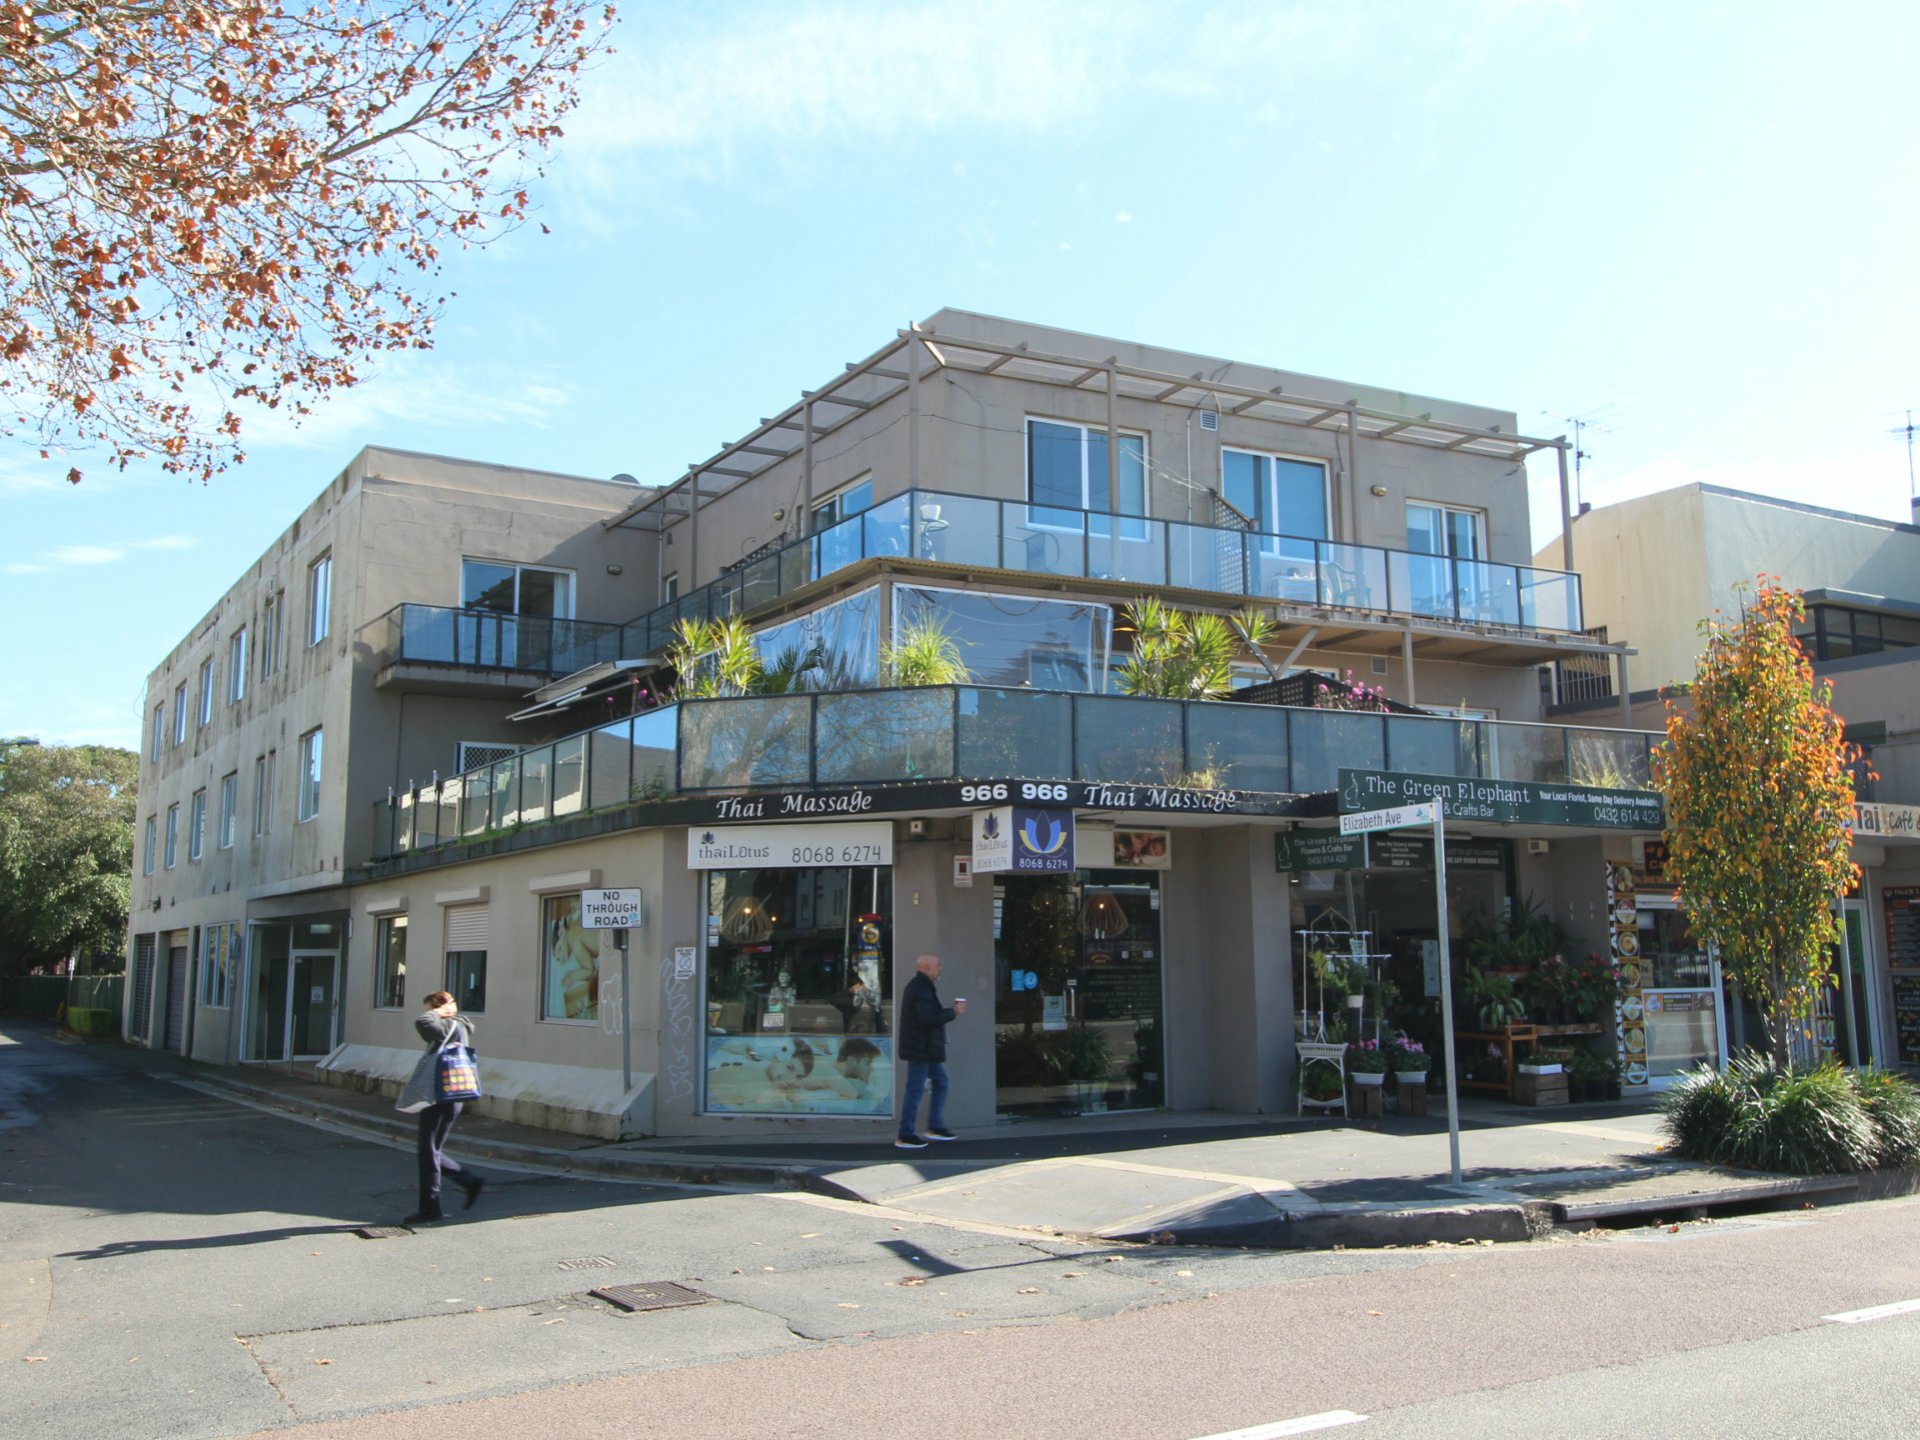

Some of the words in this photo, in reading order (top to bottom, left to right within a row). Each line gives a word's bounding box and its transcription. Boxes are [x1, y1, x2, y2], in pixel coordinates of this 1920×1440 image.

[961, 784, 1008, 802] 966
[1022, 783, 1068, 801] 966
[1084, 785, 1136, 807] Thai
[1145, 788, 1237, 812] Massage
[1366, 775, 1396, 794] The
[1403, 779, 1451, 797] Green
[1458, 782, 1531, 804] Elephant
[715, 797, 764, 818] Thai
[780, 790, 872, 814] Massage
[1539, 790, 1551, 800] Your
[1552, 792, 1567, 801] Local
[1568, 792, 1587, 804] Florist,
[1587, 793, 1602, 803] Same
[1602, 795, 1613, 805] Day
[1614, 796, 1635, 808] Delivery
[1443, 802, 1452, 815] &
[1452, 802, 1479, 817] Crafts
[1480, 804, 1494, 817] Bar
[1594, 806, 1618, 822] 0432
[1621, 808, 1639, 823] 614
[1641, 809, 1660, 824] 429
[1854, 805, 1880, 832] Taj
[1343, 811, 1383, 832] Elizabeth
[1385, 811, 1402, 825] Ave
[1307, 837, 1327, 845] Green
[1328, 835, 1360, 844] Elephant
[1343, 843, 1353, 852] Bar
[792, 846, 835, 863] 8068
[842, 845, 882, 862] 6274
[1019, 857, 1043, 869] 8068
[1046, 859, 1068, 870] 6274
[603, 891, 620, 901] NO
[586, 903, 638, 914] THROUGH
[594, 916, 629, 926] ROAD
